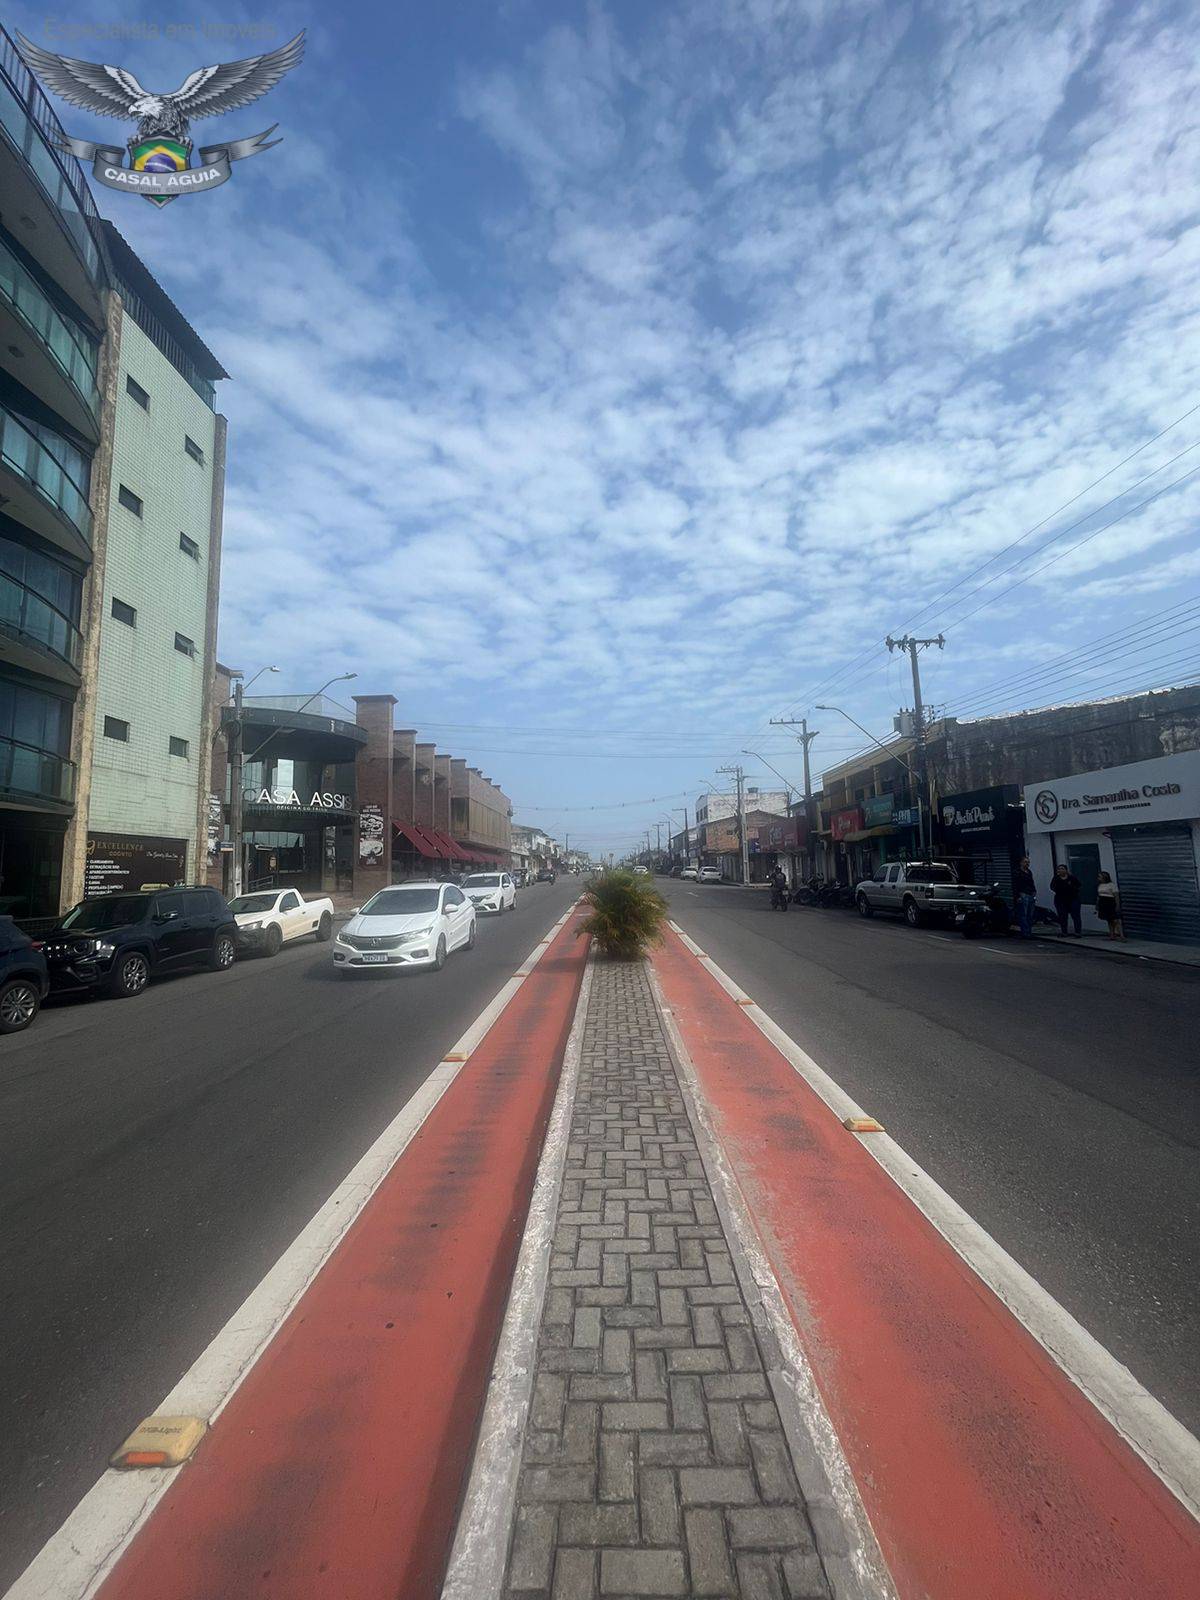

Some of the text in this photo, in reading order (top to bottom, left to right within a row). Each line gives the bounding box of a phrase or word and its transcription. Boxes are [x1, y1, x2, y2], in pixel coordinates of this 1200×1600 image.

[242, 788, 300, 806] CASA
[310, 791, 353, 810] ASSIS
[1061, 782, 1182, 810] Dra. Samantha Costa
[97, 841, 144, 851] EXCELLENCE
